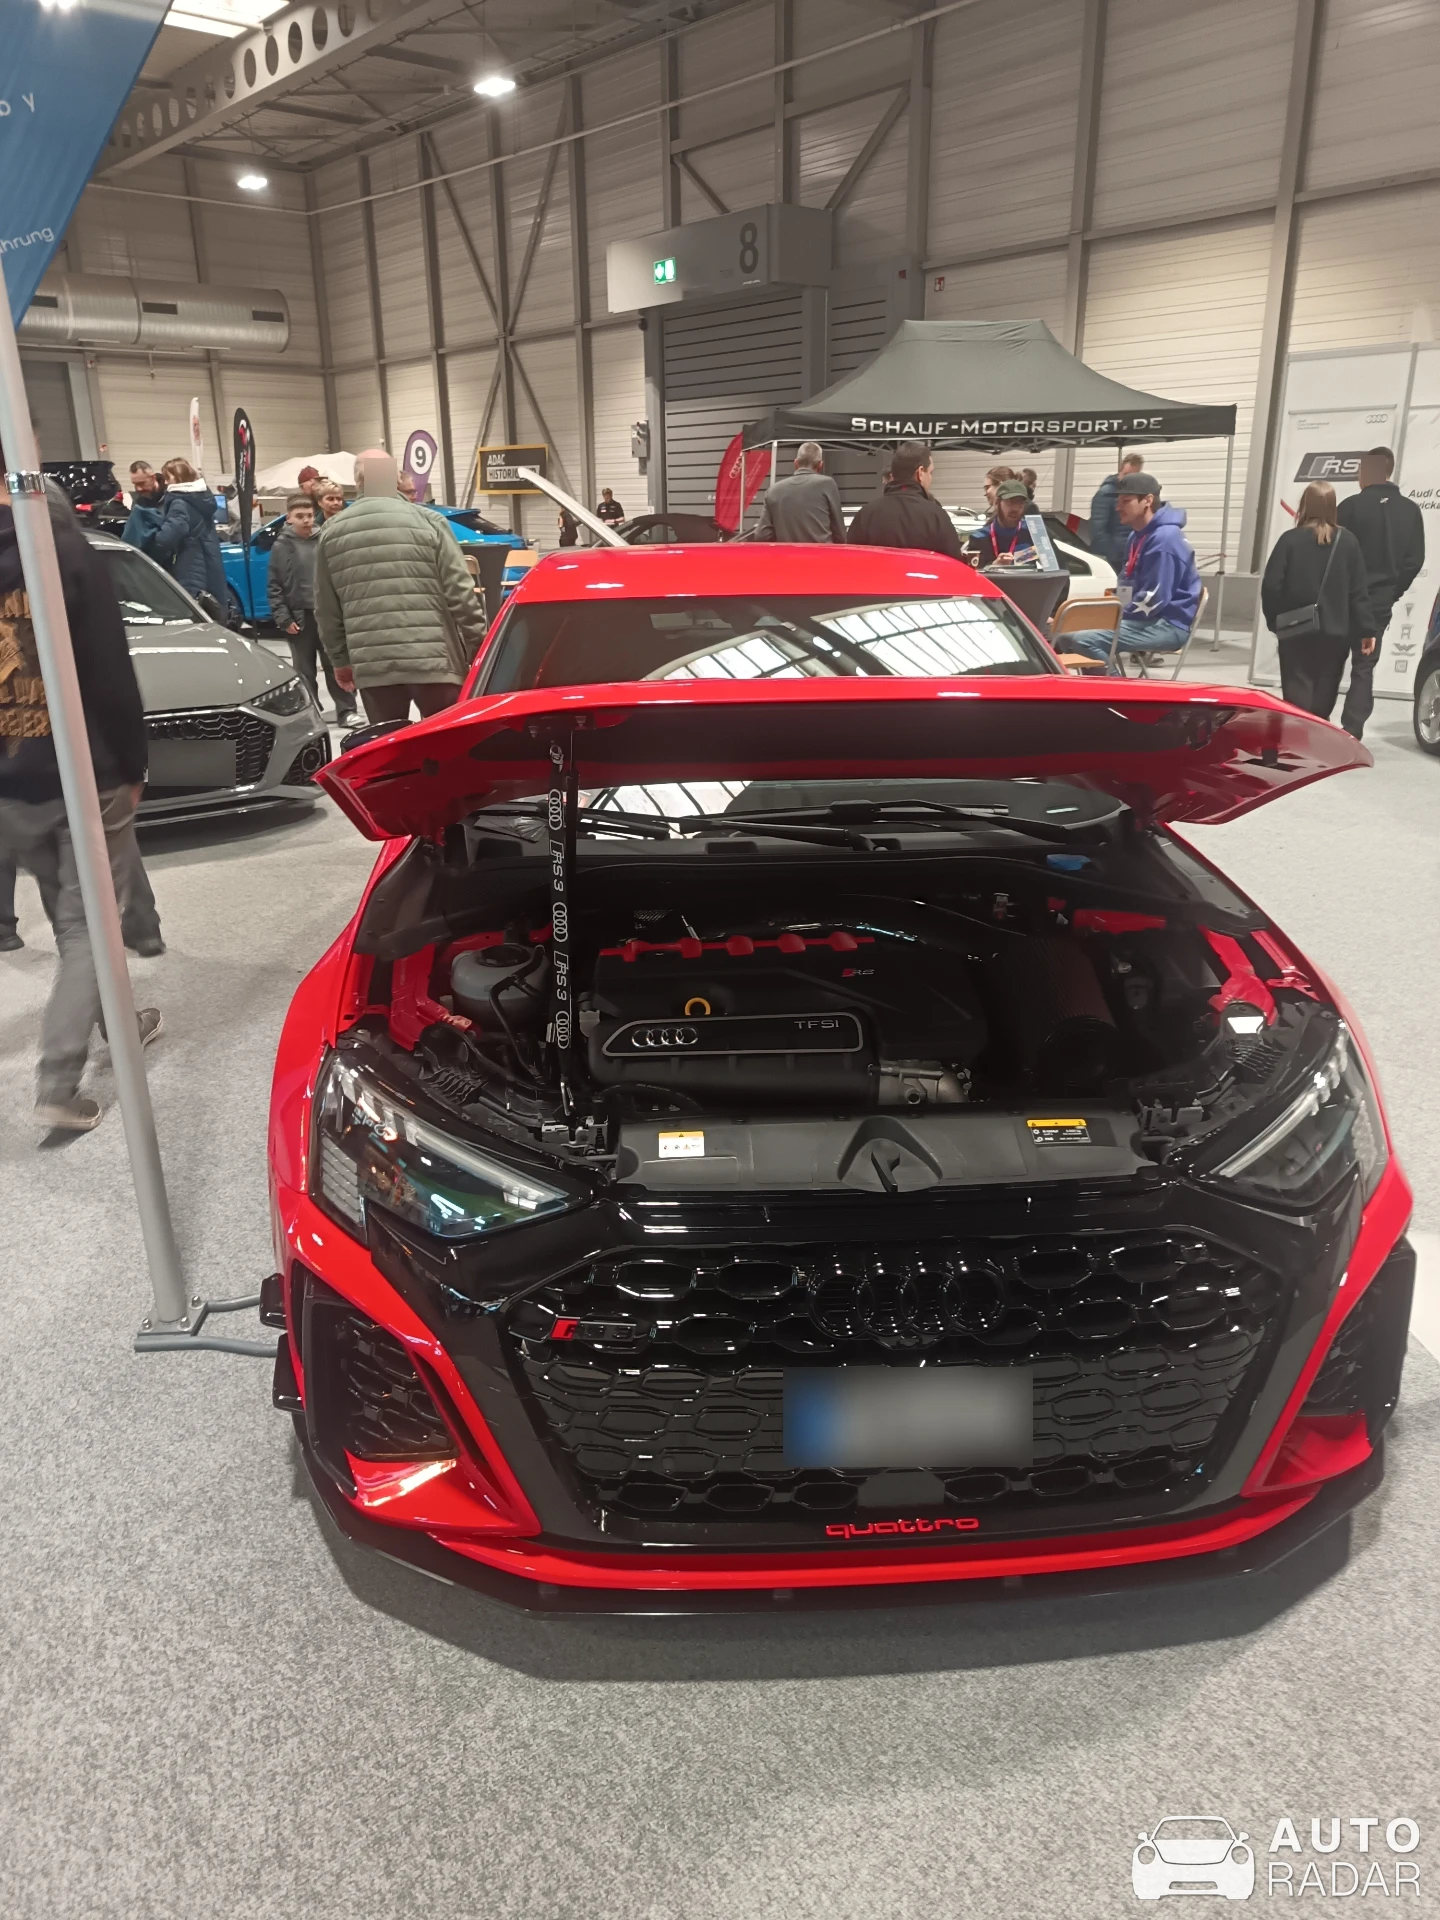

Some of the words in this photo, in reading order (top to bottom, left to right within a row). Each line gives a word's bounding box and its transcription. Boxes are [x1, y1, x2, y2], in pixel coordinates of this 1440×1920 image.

[739, 222, 759, 274] 8
[415, 446, 427, 468] 9
[487, 454, 505, 466] ADAC
[1408, 489, 1434, 498] Audi
[794, 1020, 840, 1030] TFSI
[825, 1518, 980, 1539] quattro
